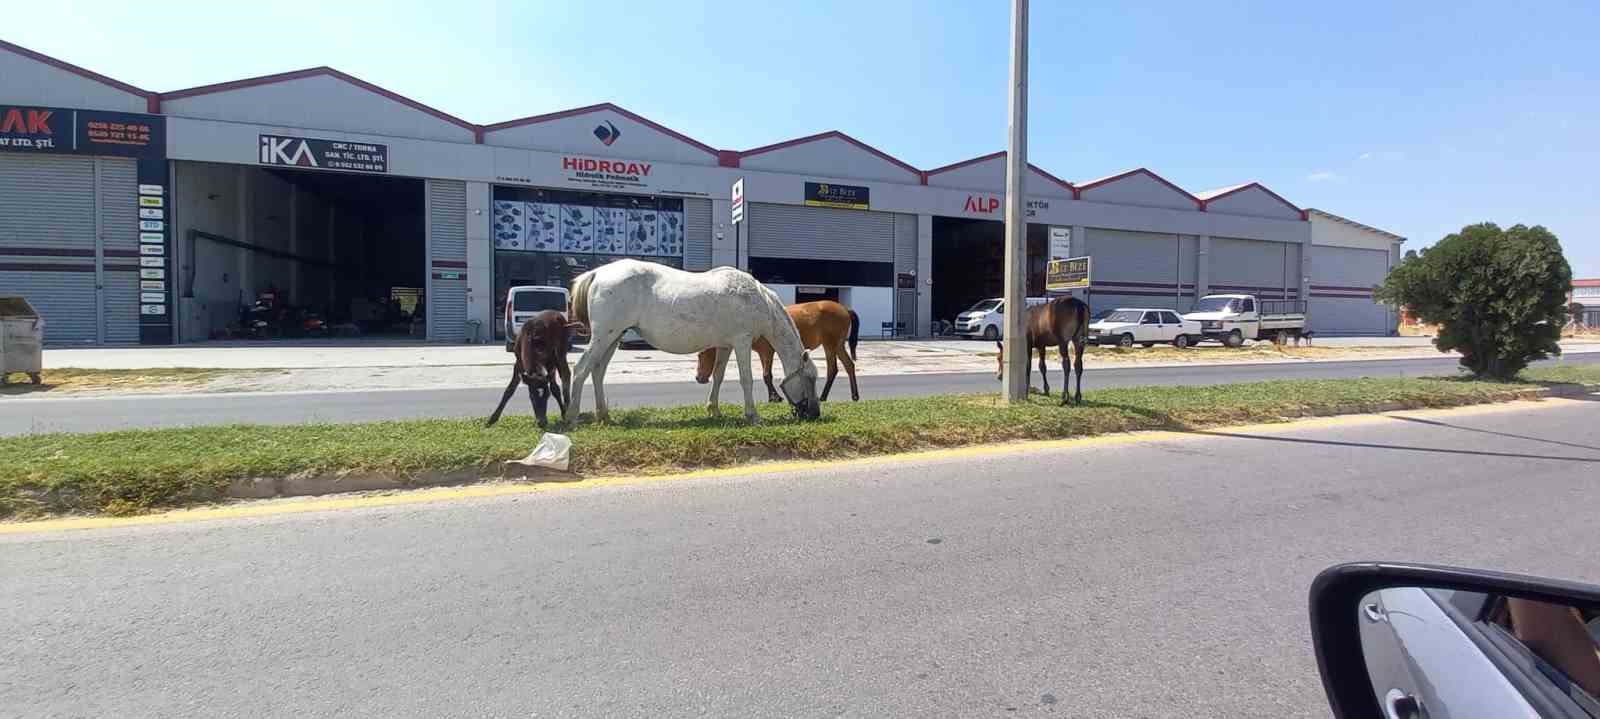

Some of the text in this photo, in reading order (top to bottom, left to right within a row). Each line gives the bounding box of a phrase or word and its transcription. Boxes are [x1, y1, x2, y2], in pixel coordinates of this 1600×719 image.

[332, 142, 347, 150] CNC
[353, 143, 377, 153] TORNA
[964, 196, 999, 213] ALP
